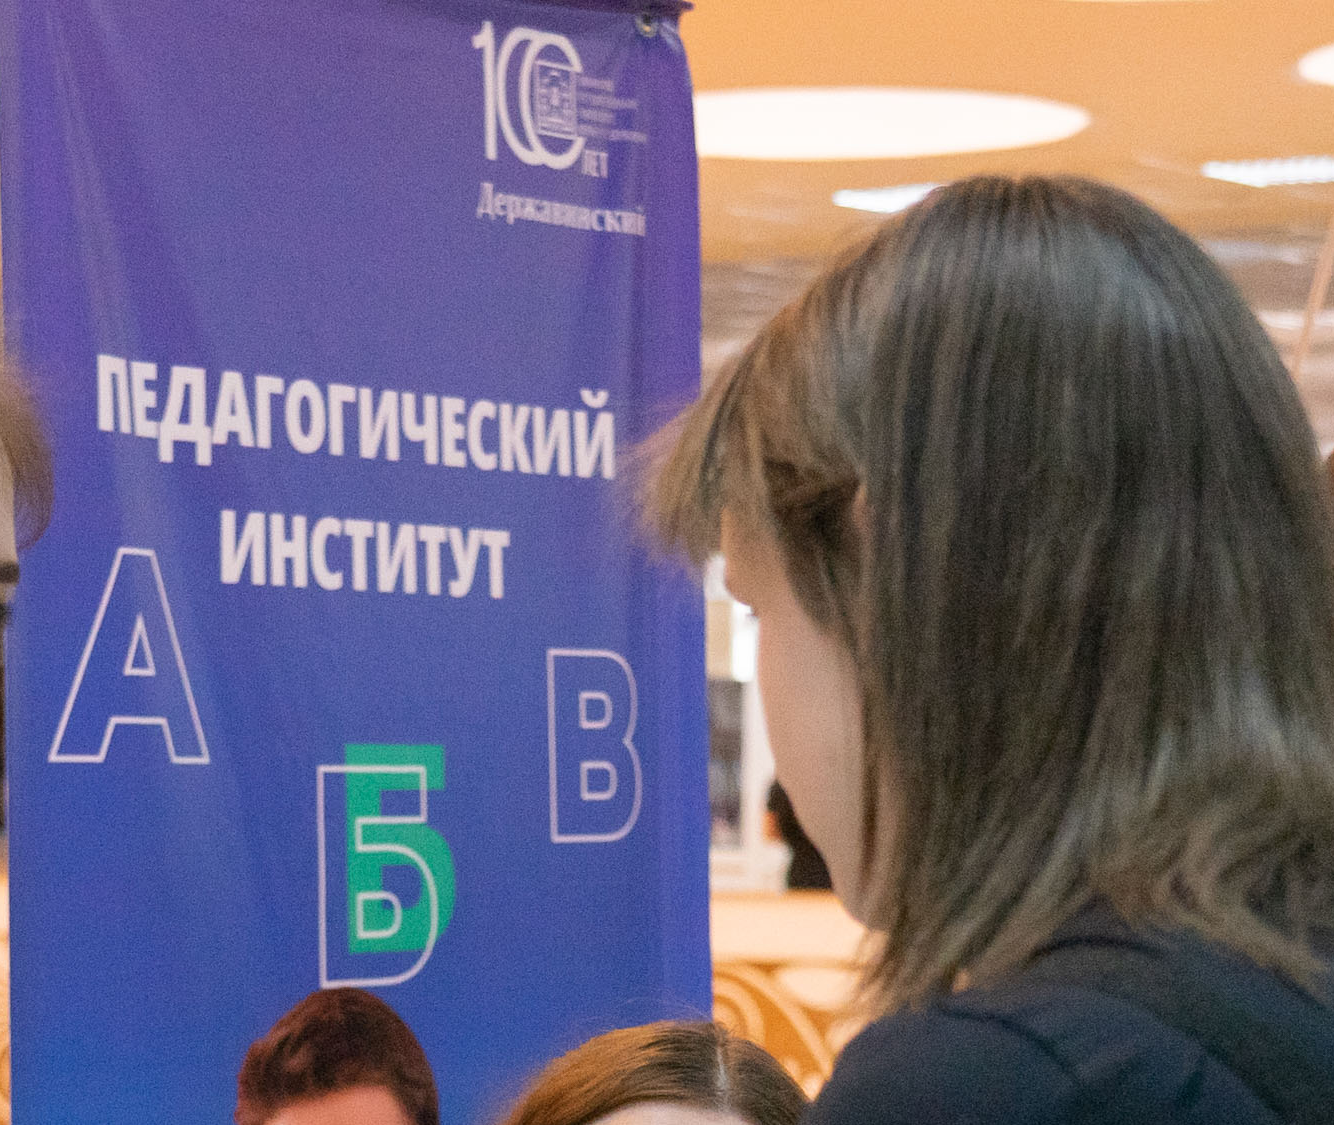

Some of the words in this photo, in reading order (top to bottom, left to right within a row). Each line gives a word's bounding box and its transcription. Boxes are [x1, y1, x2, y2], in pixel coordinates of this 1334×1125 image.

[96, 353, 616, 481] ПЕДАГОГИЧЕСКИЙ
[219, 508, 511, 600] ИНСТИТУТ
[48, 547, 210, 764] А
[546, 647, 643, 843] В
[317, 743, 457, 989] Б
